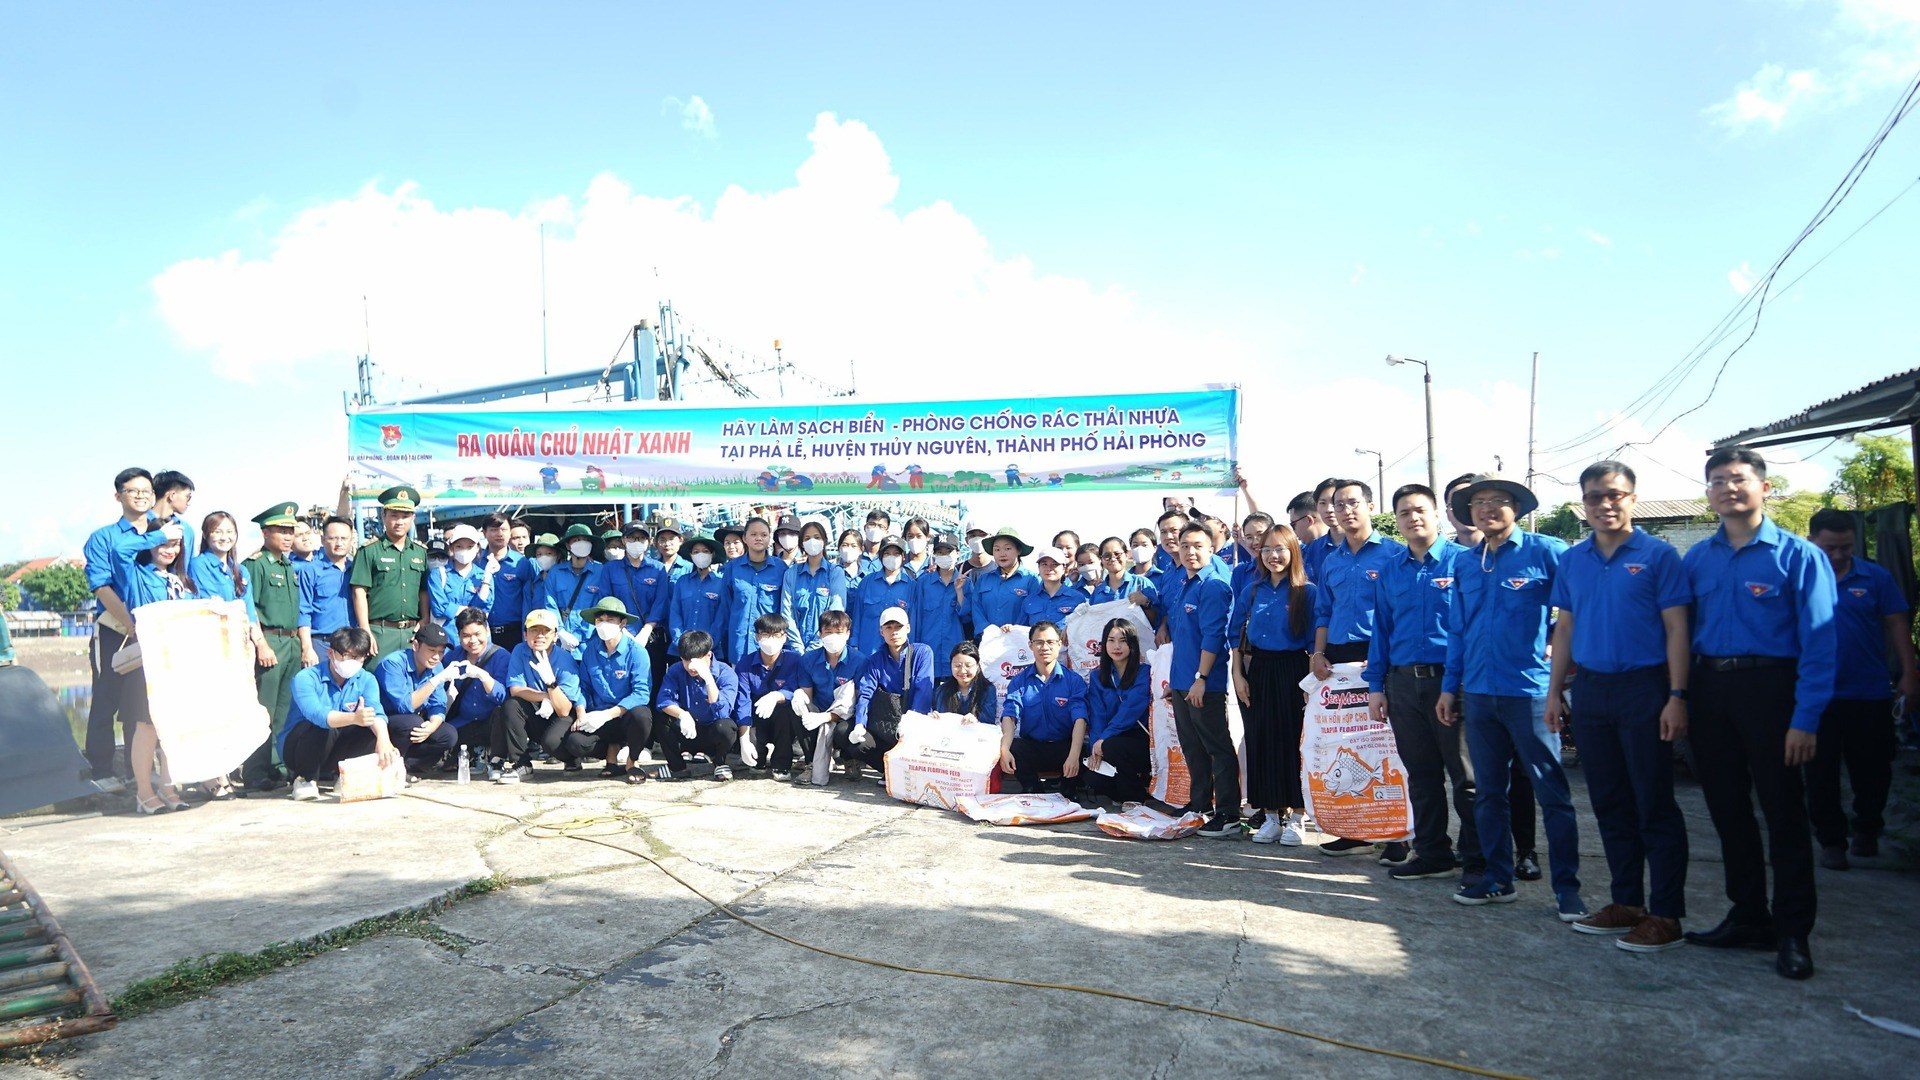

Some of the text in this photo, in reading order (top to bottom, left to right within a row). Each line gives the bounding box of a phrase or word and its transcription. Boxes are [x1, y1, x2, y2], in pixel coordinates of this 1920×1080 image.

[722, 419, 756, 436] HÃY
[760, 418, 794, 436] LÀM
[797, 420, 844, 439] SẠCH
[848, 411, 884, 433] BIỂN
[902, 413, 965, 432] PHÒNG
[970, 409, 1037, 430] CHỐNG
[1042, 409, 1079, 428] RÁC
[1084, 406, 1123, 427] THẢI
[1129, 407, 1180, 428] NHỰA
[458, 425, 692, 460] RA QUÂN CHỦ NHẬT XANH
[720, 445, 745, 462] TẠI
[749, 439, 782, 458] PHẢ
[812, 439, 866, 461] HUYỆN
[870, 436, 912, 456] THỦY
[917, 436, 991, 456] NGUYÊN,
[996, 434, 1055, 453] THÀNH
[1060, 430, 1098, 452] PHỐ
[1103, 430, 1134, 450] HẢI
[1139, 429, 1207, 449] PHÒNG
[1320, 685, 1370, 711] SeaMast
[1339, 724, 1369, 733] FLOATING
